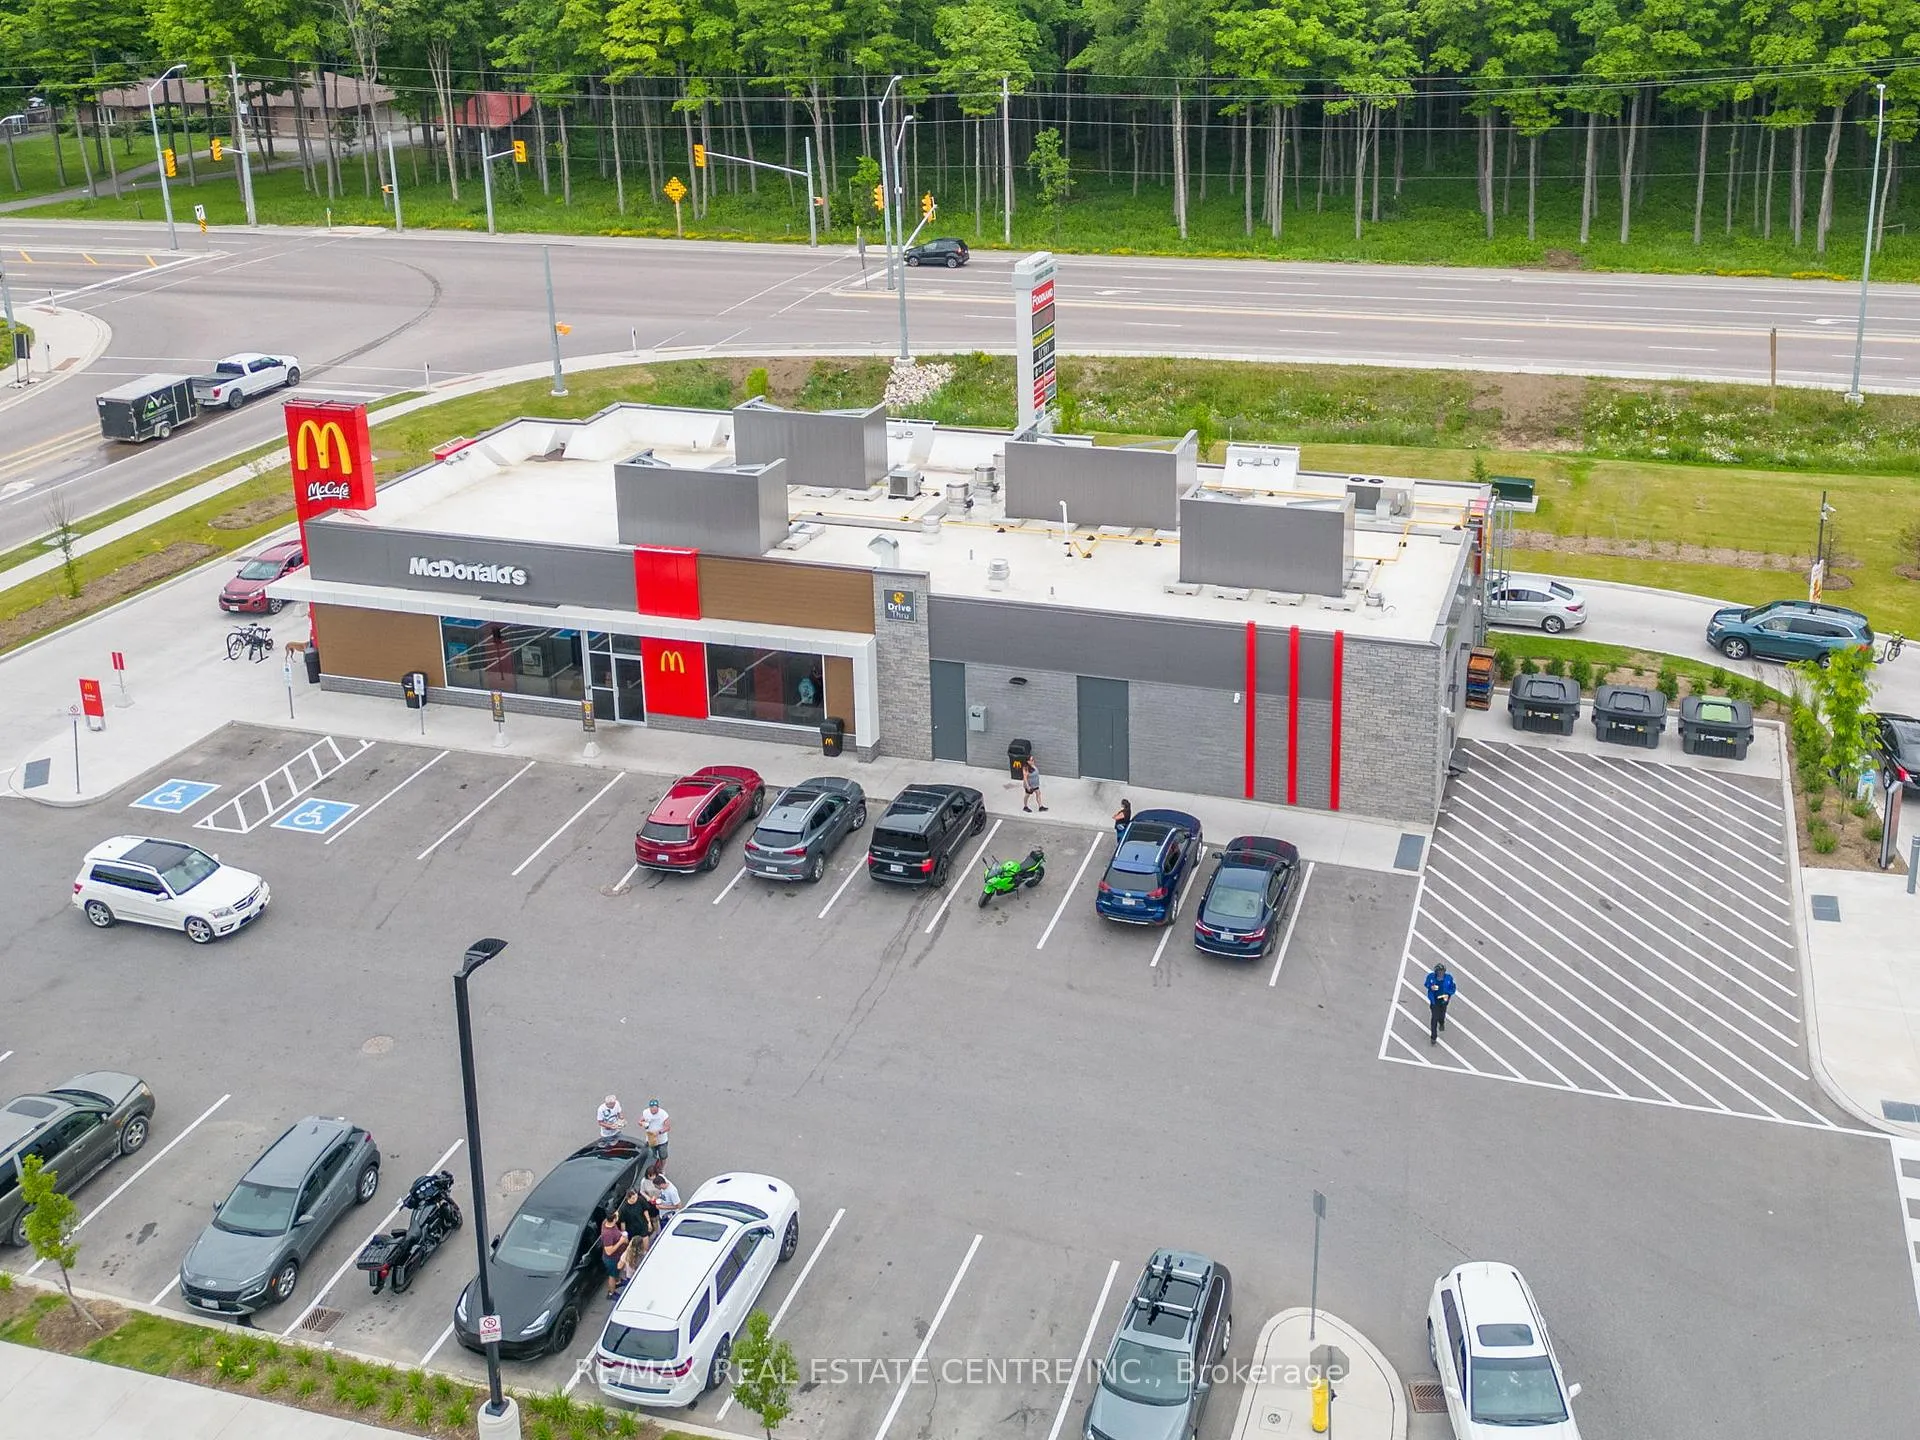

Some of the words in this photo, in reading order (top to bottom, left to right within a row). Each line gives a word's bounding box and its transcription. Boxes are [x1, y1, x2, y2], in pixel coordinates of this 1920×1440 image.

[307, 481, 350, 501] McCafé
[409, 557, 527, 585] McDonald's
[887, 602, 912, 612] Drive
